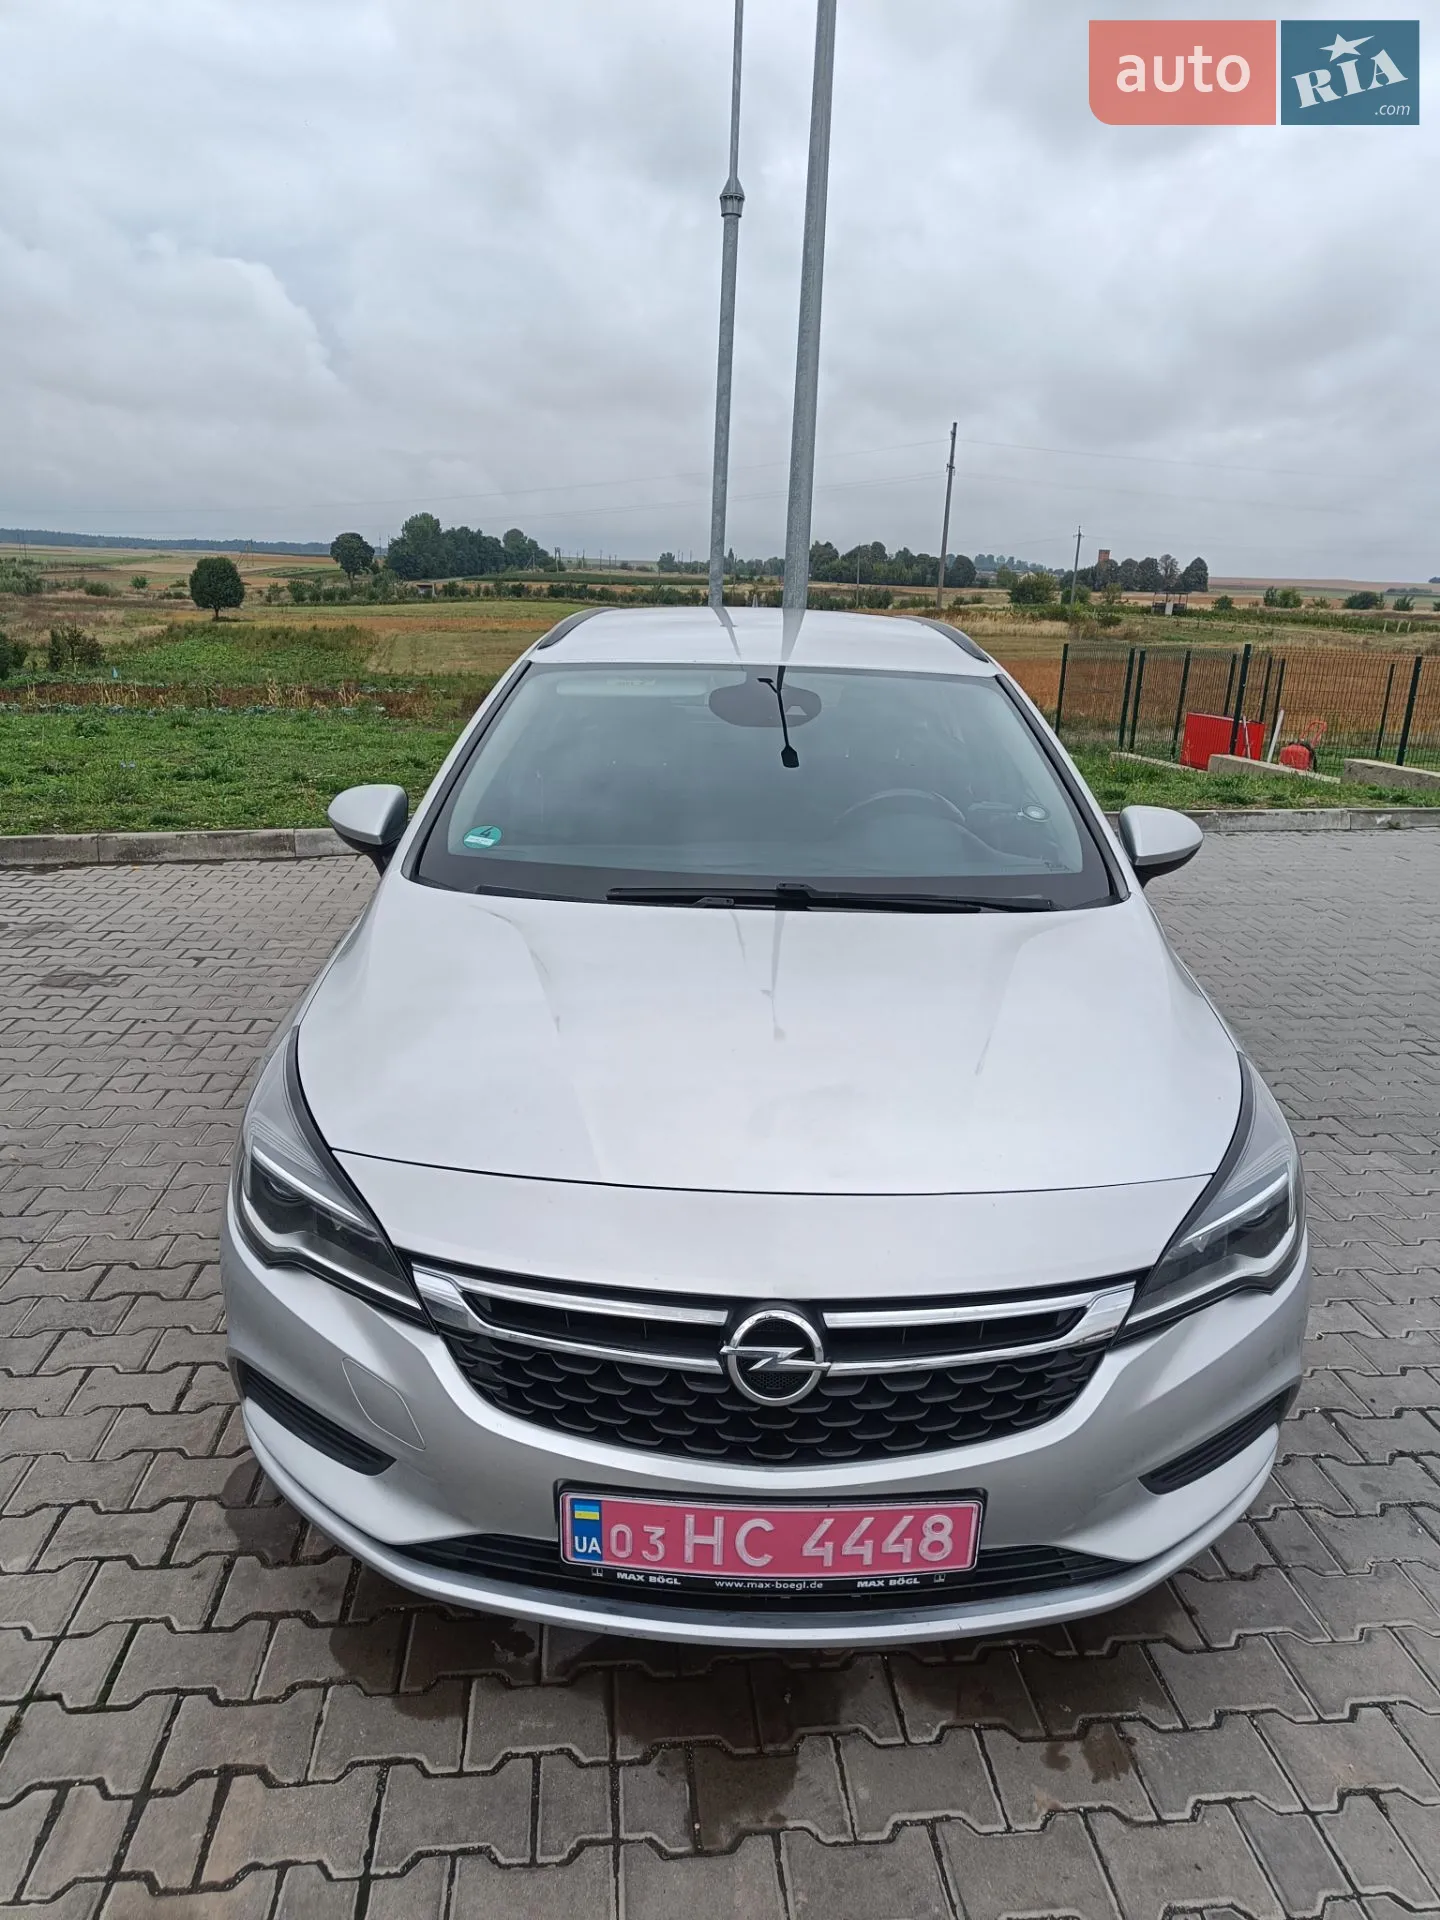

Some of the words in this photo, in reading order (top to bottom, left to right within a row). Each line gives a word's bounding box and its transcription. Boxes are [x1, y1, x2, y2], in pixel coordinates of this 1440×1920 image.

[480, 826, 494, 838] 4
[574, 1536, 602, 1555] UA
[609, 1523, 666, 1562] 03
[684, 1514, 775, 1568] HC
[801, 1513, 955, 1568] 4448
[616, 1571, 645, 1582] MAX
[648, 1574, 681, 1586] BÖGL
[714, 1579, 824, 1591] www.max-boegl.de
[856, 1579, 885, 1589] MAX
[888, 1577, 921, 1587] BÖGL
